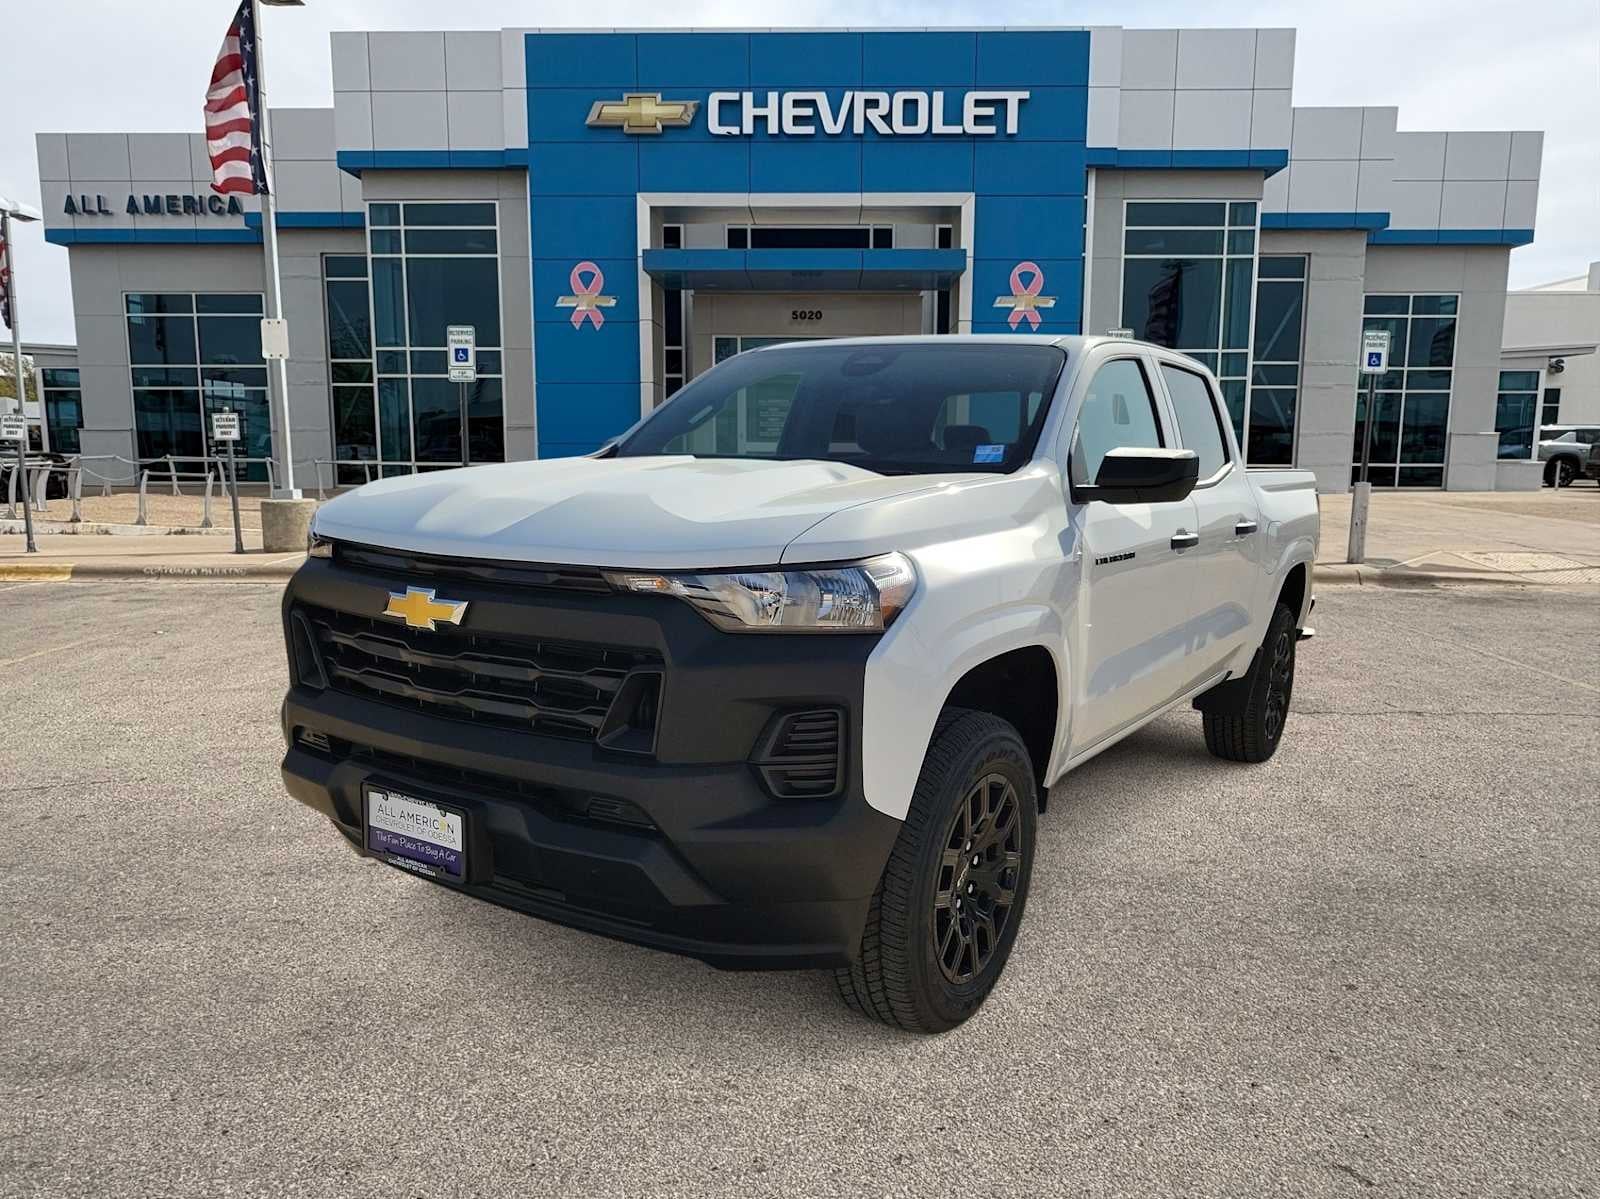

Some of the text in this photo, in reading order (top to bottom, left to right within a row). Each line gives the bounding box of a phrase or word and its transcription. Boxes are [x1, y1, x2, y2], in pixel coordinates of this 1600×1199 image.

[708, 91, 1030, 135] CHEVROLET
[64, 194, 243, 216] ALL AMERICA
[791, 310, 823, 320] 5020
[377, 803, 455, 834] ALL AMERICN
[376, 831, 388, 842] The
[400, 838, 416, 850] Place
[416, 843, 425, 853] To
[439, 850, 445, 859] A
